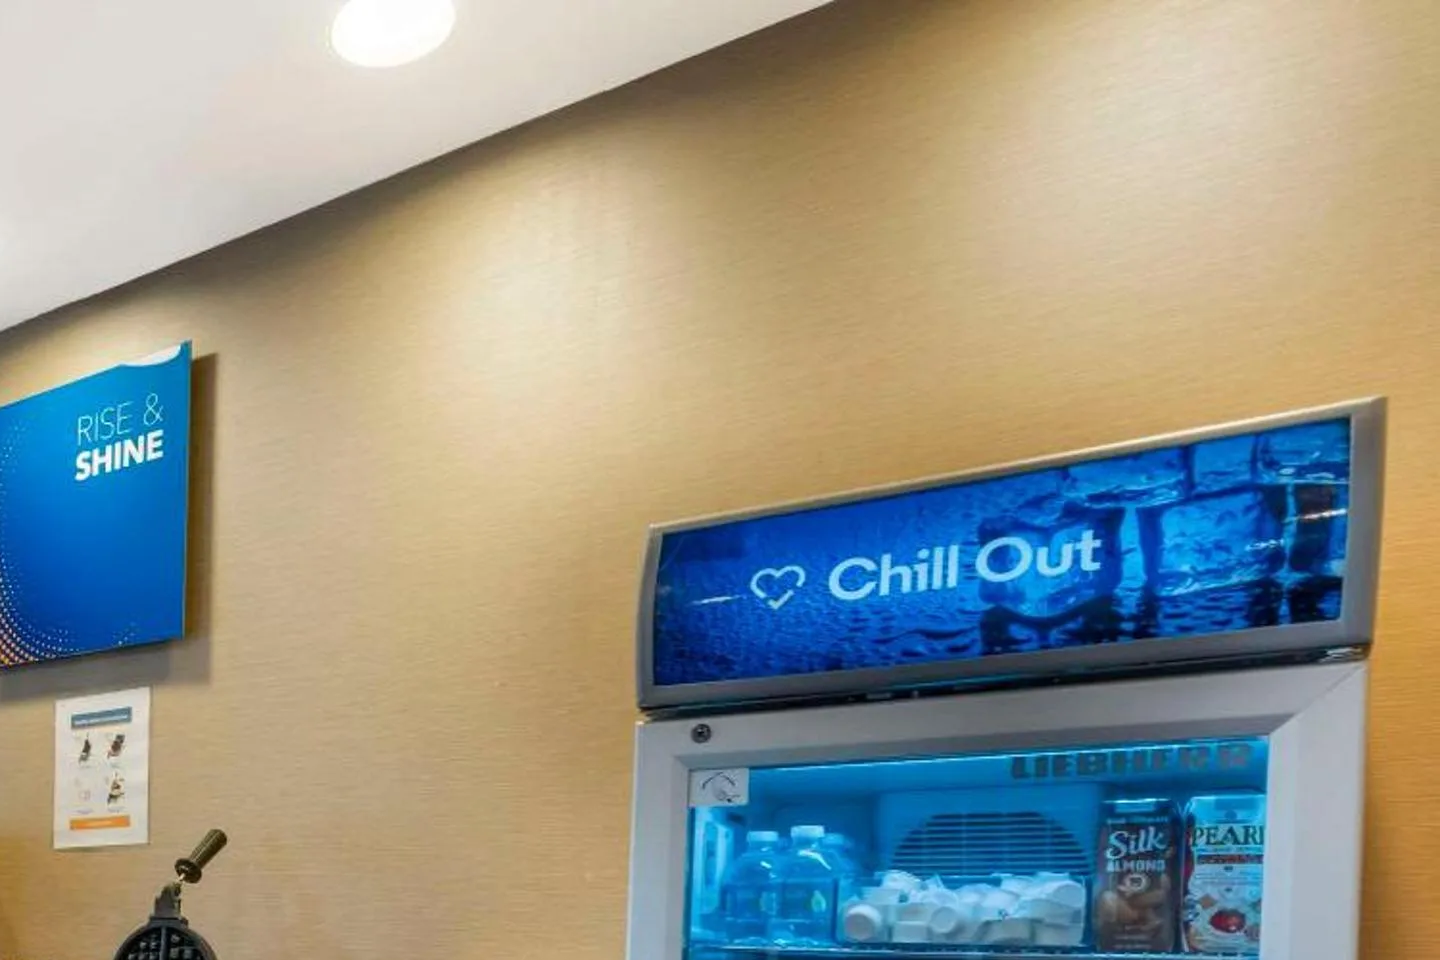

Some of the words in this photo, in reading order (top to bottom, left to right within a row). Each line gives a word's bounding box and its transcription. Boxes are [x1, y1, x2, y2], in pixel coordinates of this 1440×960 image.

[77, 401, 134, 446] RISE
[143, 392, 164, 427] &
[75, 429, 164, 482] SHINE
[828, 545, 958, 600] Chill
[975, 529, 1102, 583] Out
[1106, 826, 1167, 859] Silk
[1106, 859, 1165, 872] ALMOND
